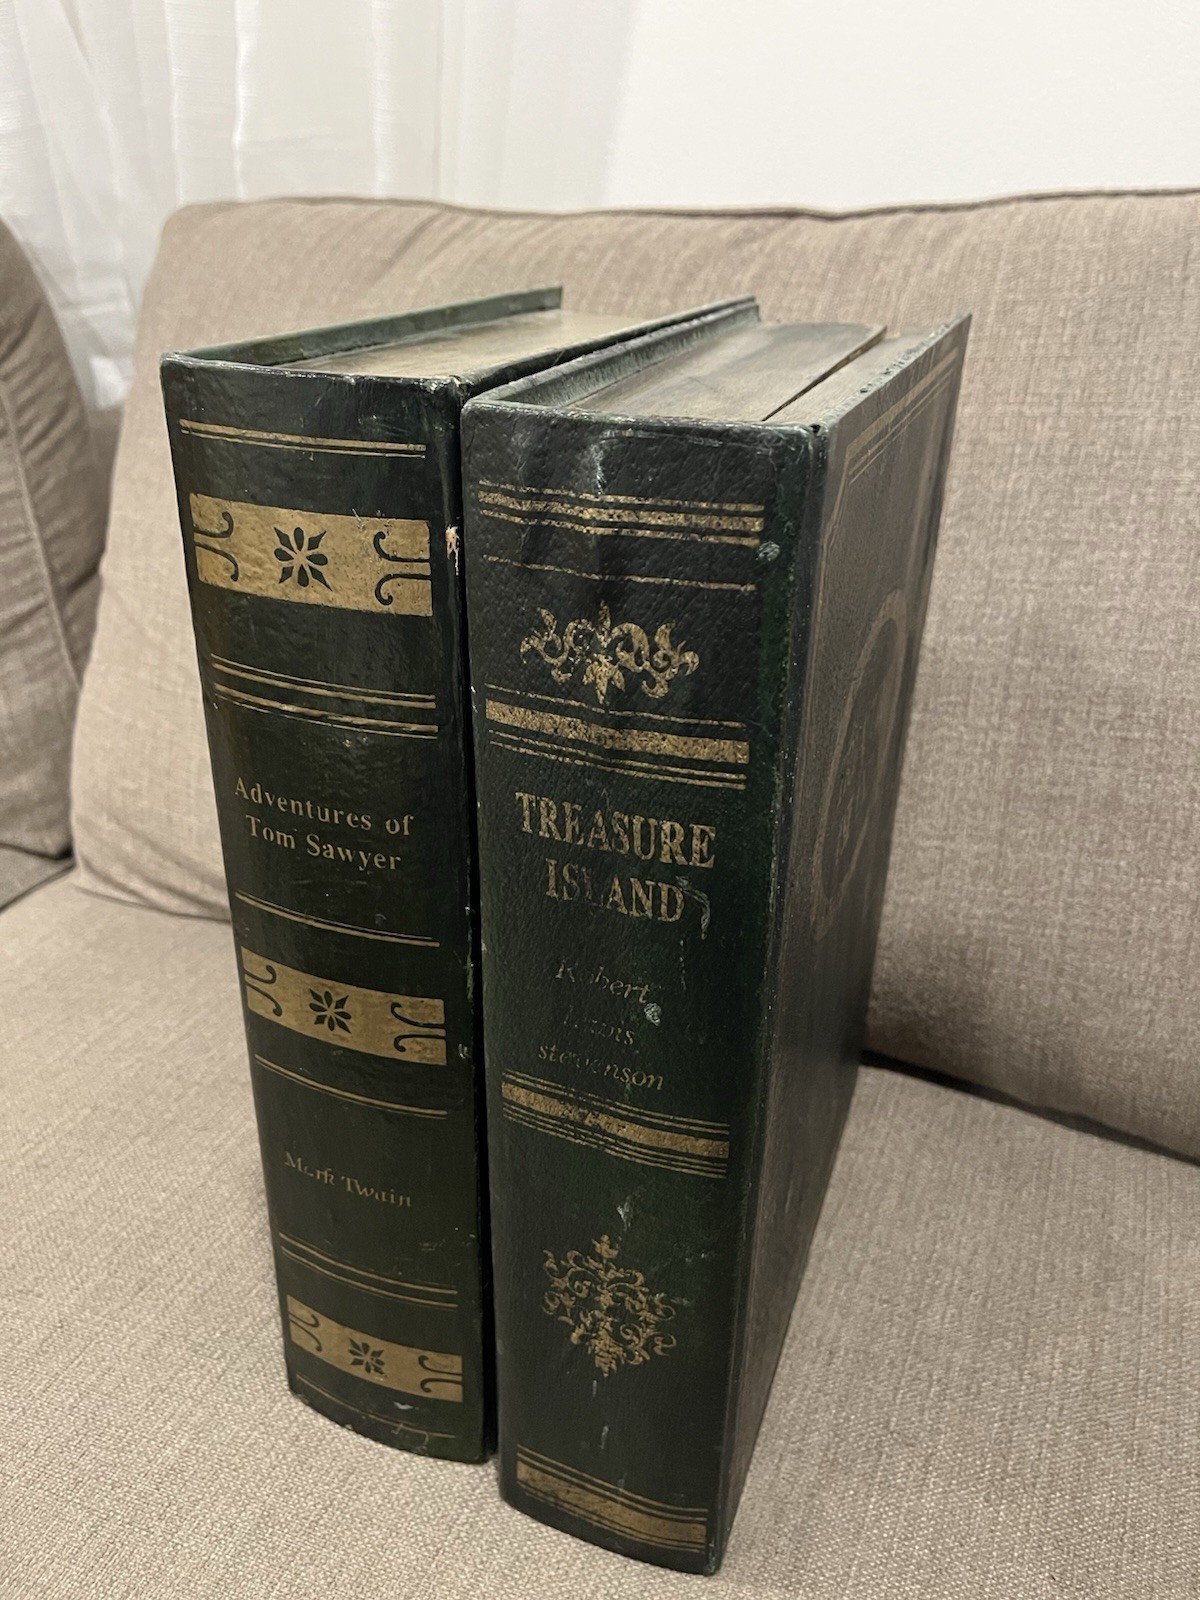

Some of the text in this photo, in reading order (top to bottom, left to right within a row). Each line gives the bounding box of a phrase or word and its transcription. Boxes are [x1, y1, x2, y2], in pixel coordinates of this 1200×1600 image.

[235, 776, 414, 836] Adventures of
[515, 791, 716, 868] TREASURE
[245, 814, 402, 871] Tom Sawyer
[555, 959, 650, 1003] Rbert
[340, 1175, 411, 1207] Twain
